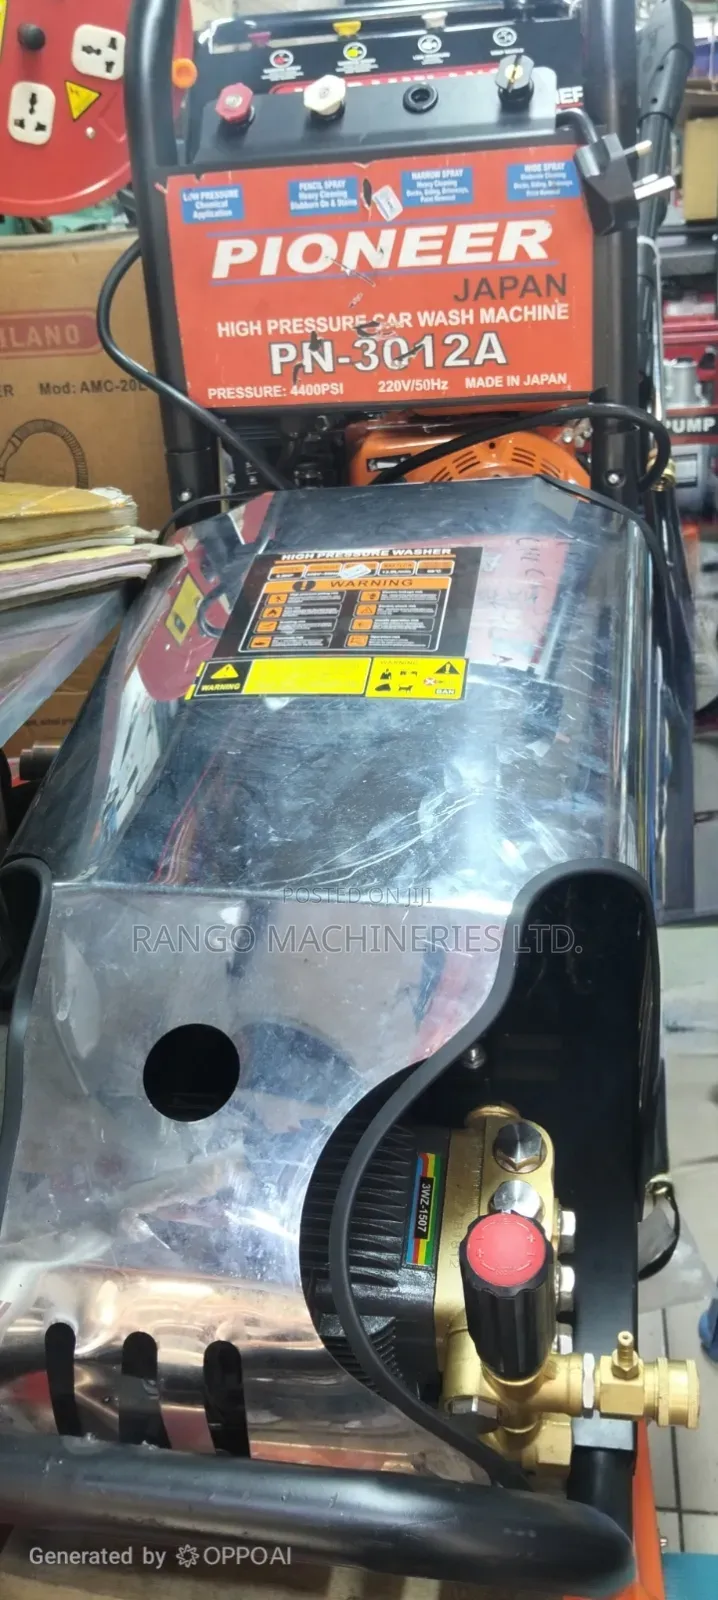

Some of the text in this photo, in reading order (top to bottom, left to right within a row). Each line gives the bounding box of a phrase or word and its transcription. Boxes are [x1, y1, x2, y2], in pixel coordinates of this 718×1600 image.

[543, 161, 566, 171] SPRAY
[442, 168, 464, 178] SPRAY
[324, 179, 346, 189] SPRAY
[200, 189, 239, 200] PRESSURE
[195, 200, 228, 210] Chemical
[192, 209, 232, 221] Application
[211, 218, 553, 279] PIONEER
[453, 273, 568, 303] JAPAN
[217, 320, 262, 338] HIGH
[266, 314, 367, 335] PRESSURE
[417, 307, 475, 327] WASH
[479, 302, 570, 325] MACHINE
[268, 331, 509, 378] PN-3012A
[39, 381, 76, 396] Mod:
[207, 373, 568, 400] PRESSURE: 4400PSI 220V/50Hz MADE IN JAPAN
[281, 548, 451, 561] HIGH PRESSURE WASHER
[330, 578, 413, 588] WARNING
[201, 683, 241, 691] WARNING
[417, 1183, 431, 1233] 3WZ-1507
